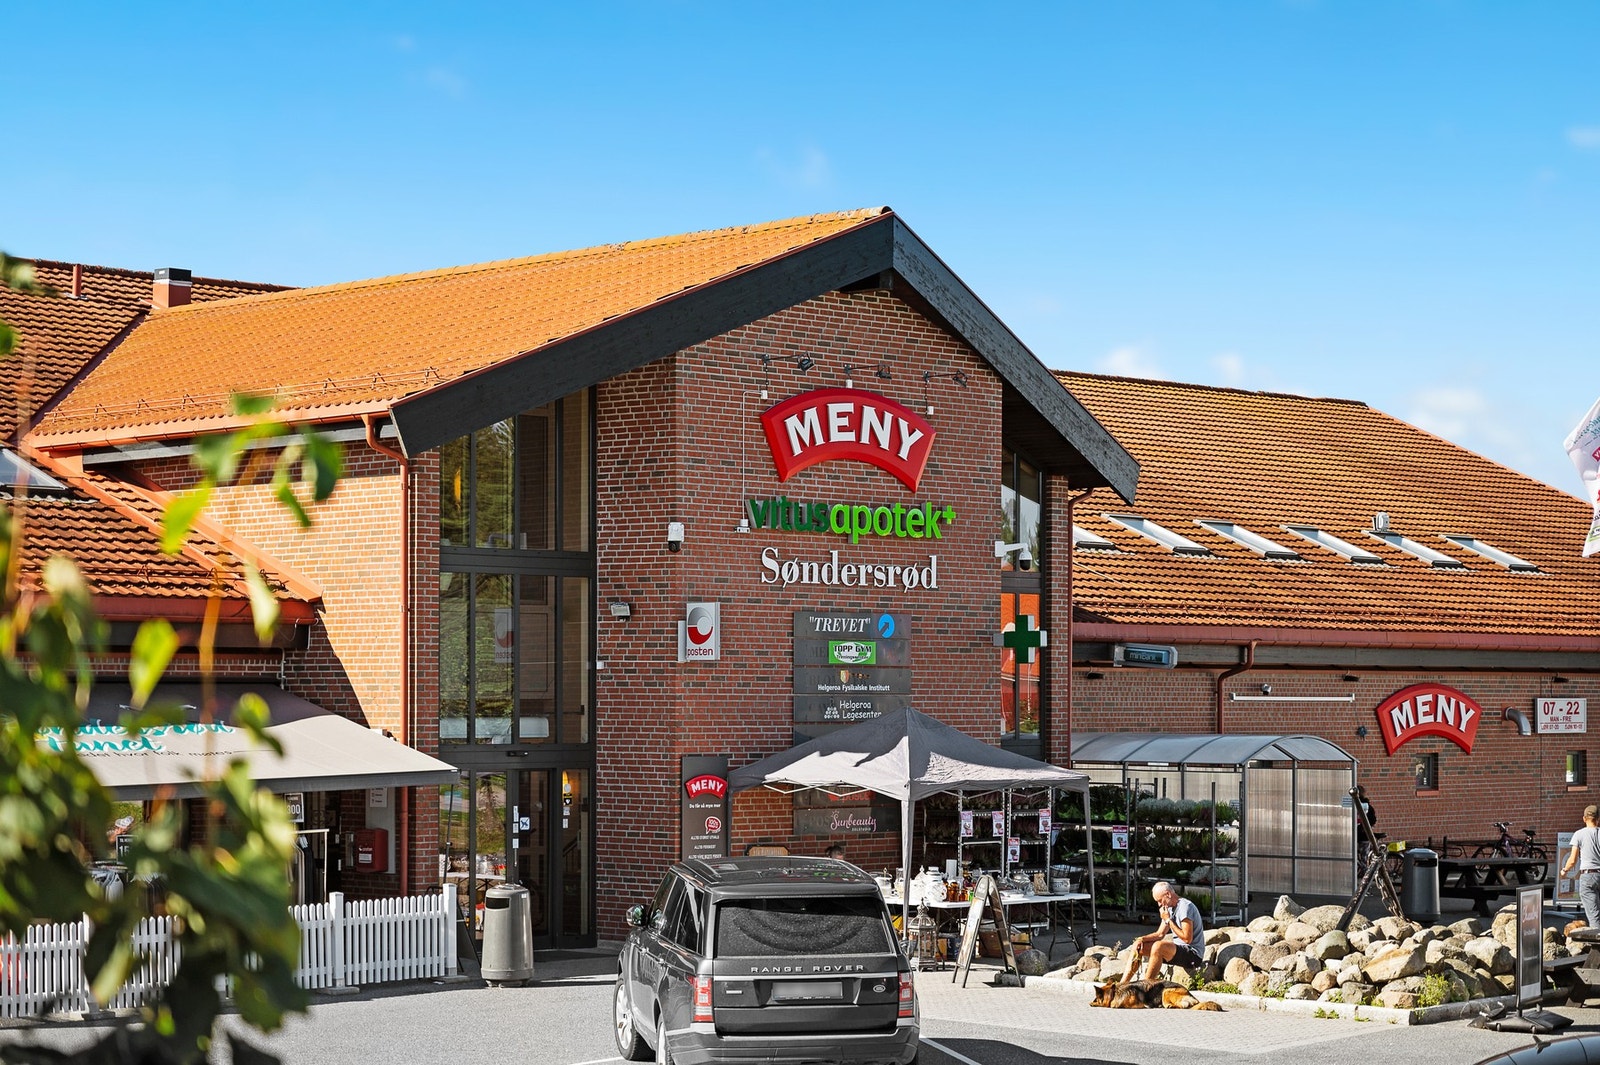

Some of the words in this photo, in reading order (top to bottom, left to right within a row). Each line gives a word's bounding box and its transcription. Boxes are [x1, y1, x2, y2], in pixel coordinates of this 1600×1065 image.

[784, 402, 924, 461] MENY
[761, 546, 939, 593] Søndersrød
[809, 616, 871, 633] "TREVET"
[687, 646, 714, 657] posten
[855, 645, 872, 653] GYM
[818, 684, 841, 692] Helgeroa
[842, 684, 868, 692] Fysikalske
[869, 684, 890, 692] Institutt
[839, 700, 872, 711] Helgeroa
[1543, 701, 1556, 715] 07
[1566, 701, 1580, 715] 22
[842, 710, 882, 721] Legesenter
[1390, 693, 1476, 738] MENY
[691, 779, 723, 794] MENY
[830, 812, 877, 832] Sunbeauty
[813, 964, 865, 972] ROVER
